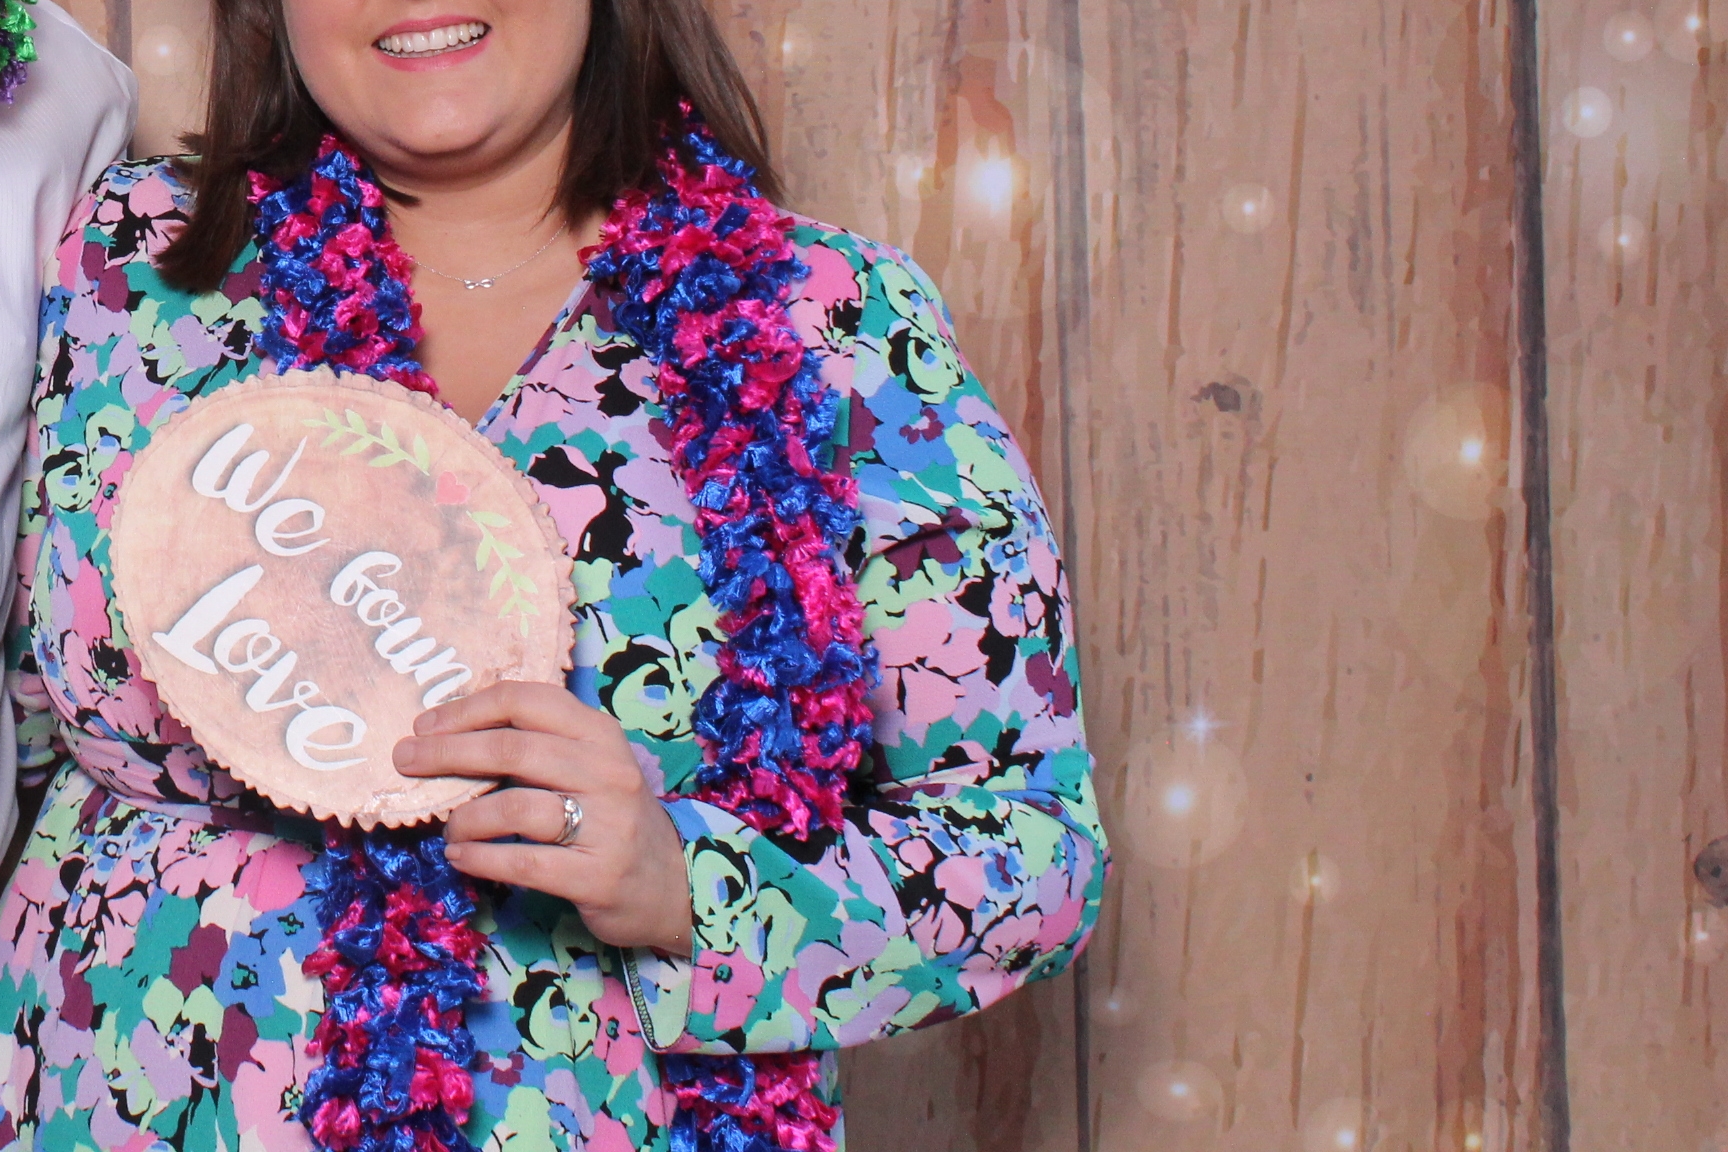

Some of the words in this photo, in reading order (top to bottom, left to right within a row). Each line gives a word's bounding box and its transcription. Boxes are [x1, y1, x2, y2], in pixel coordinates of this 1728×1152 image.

[152, 564, 368, 771] Love
[192, 423, 331, 557] We
[329, 551, 472, 710] foun
